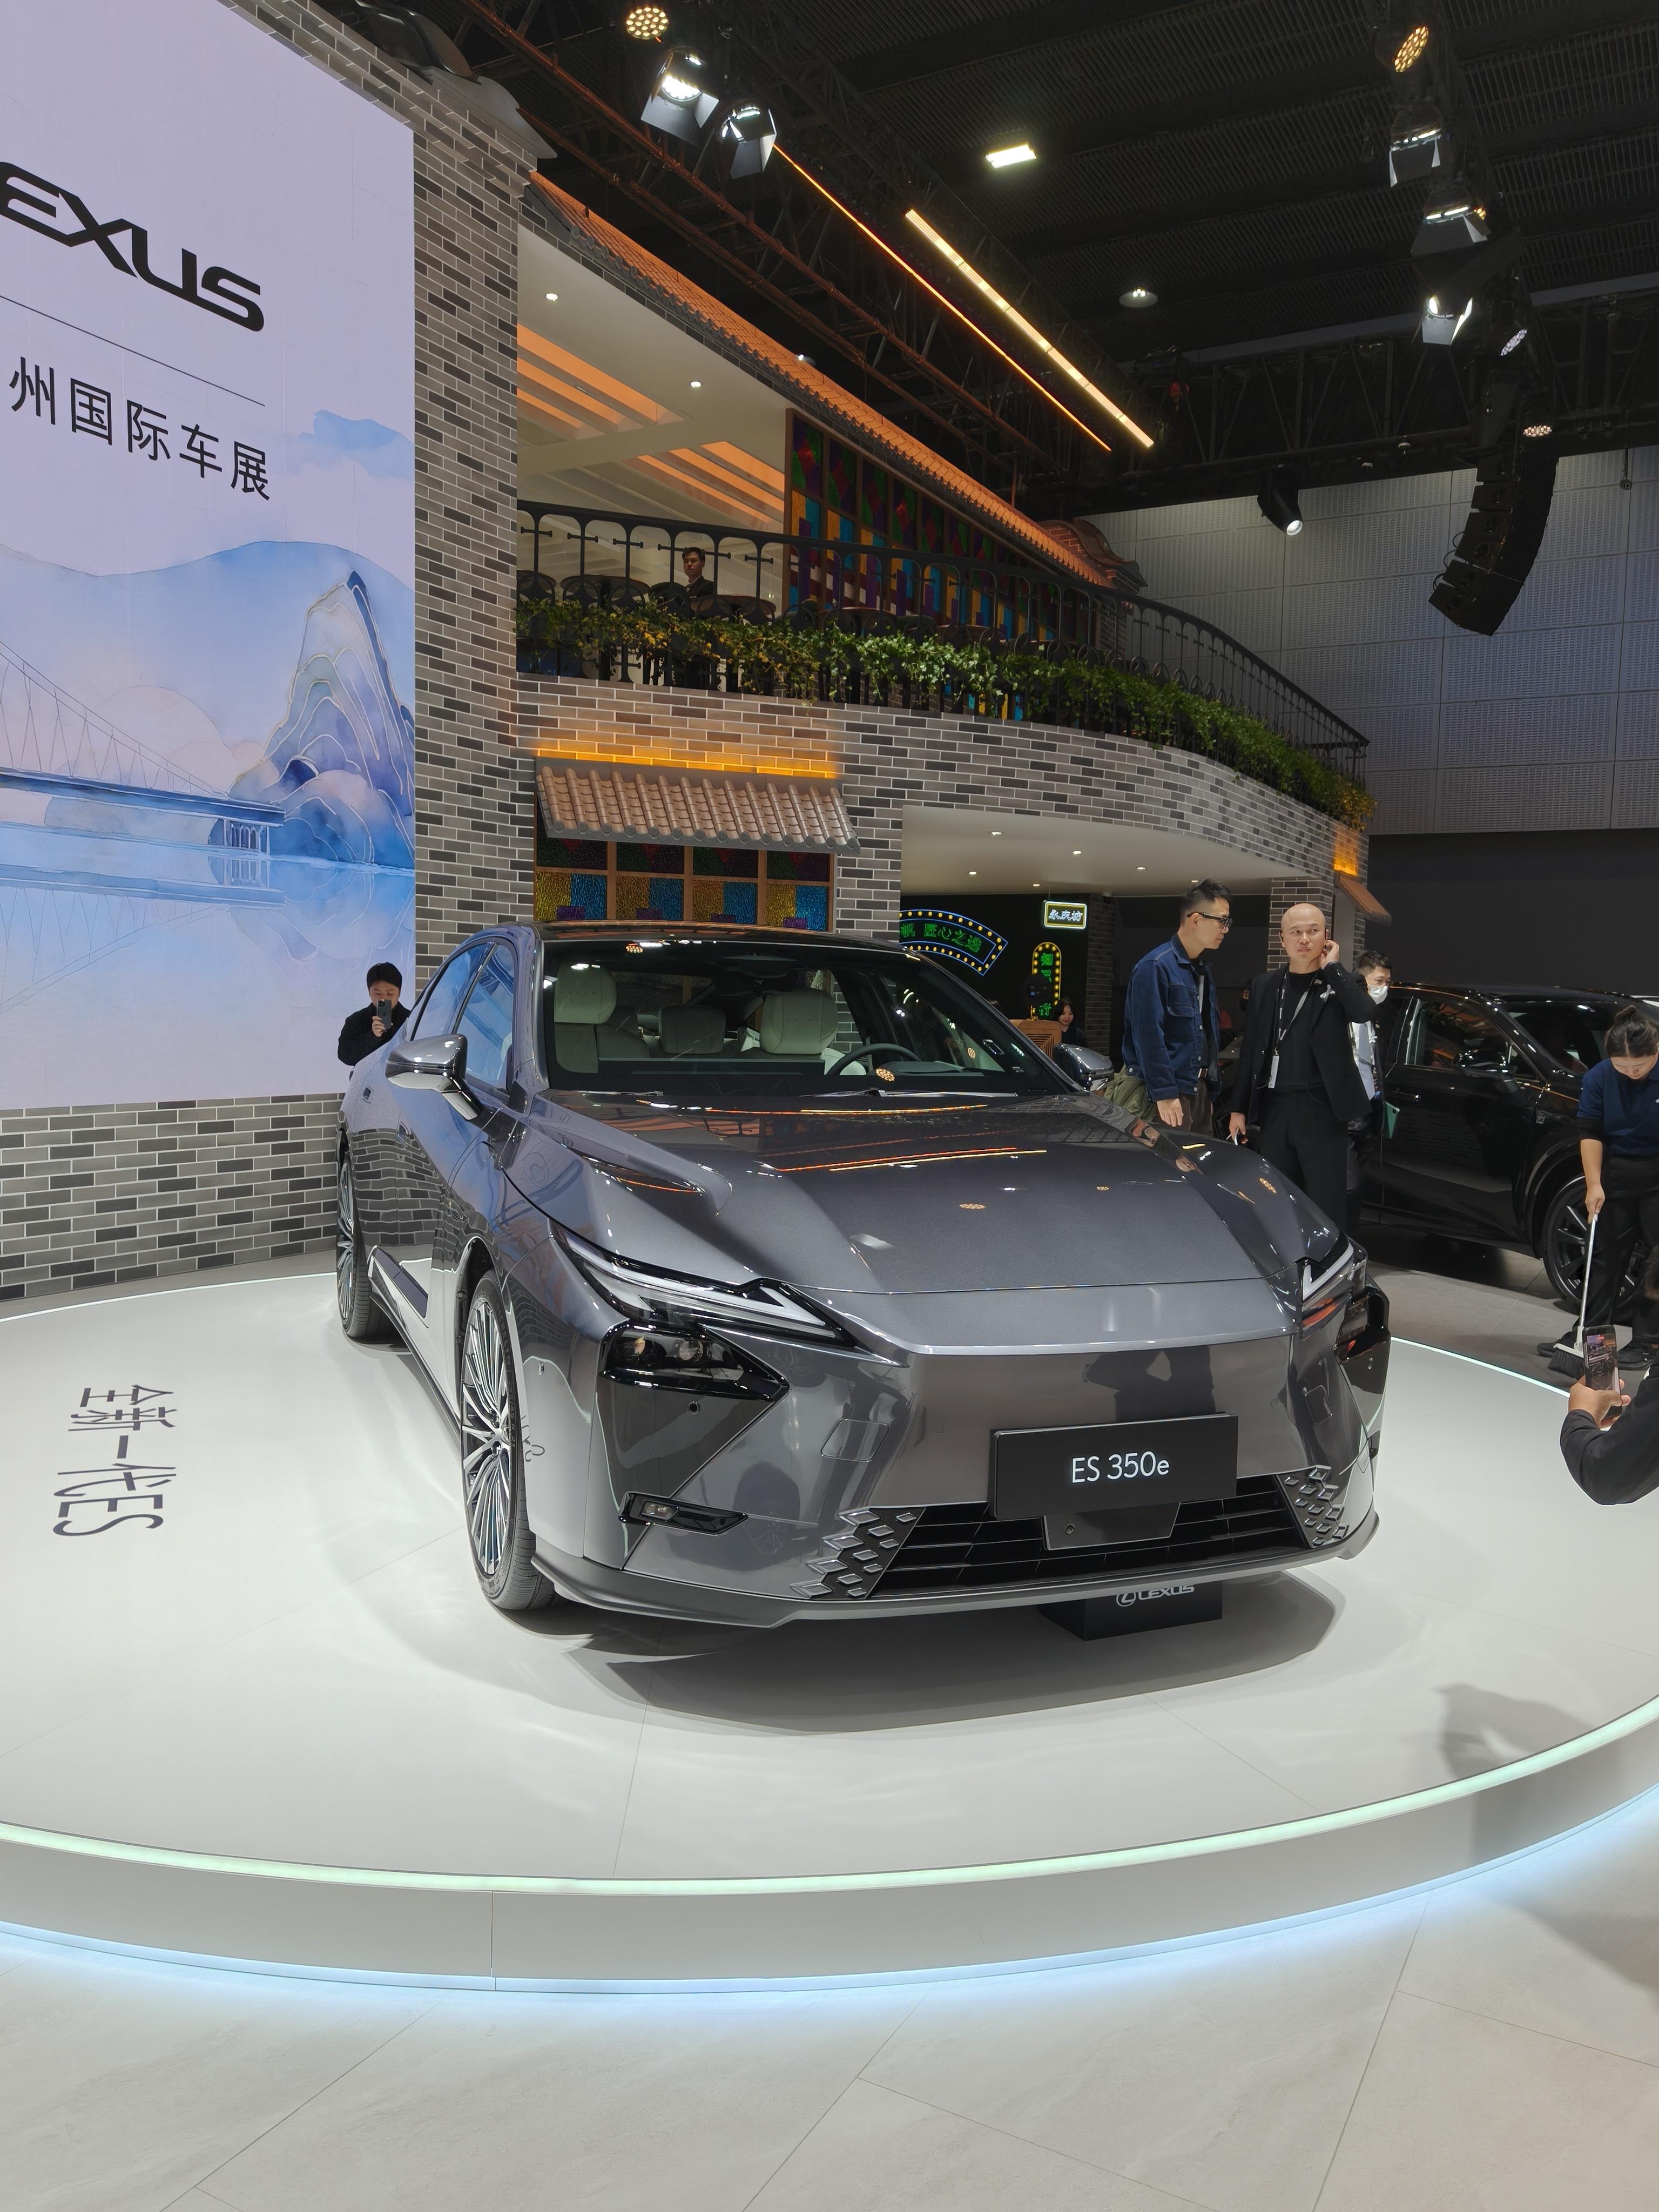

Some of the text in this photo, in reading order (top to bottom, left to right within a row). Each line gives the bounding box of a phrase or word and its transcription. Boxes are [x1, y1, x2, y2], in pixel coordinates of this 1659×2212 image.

[0, 161, 264, 332] EXUS
[9, 356, 270, 501] 州国际车展
[1071, 1451, 1170, 1483] ES 350e
[1138, 1584, 1195, 1601] LEXUS
